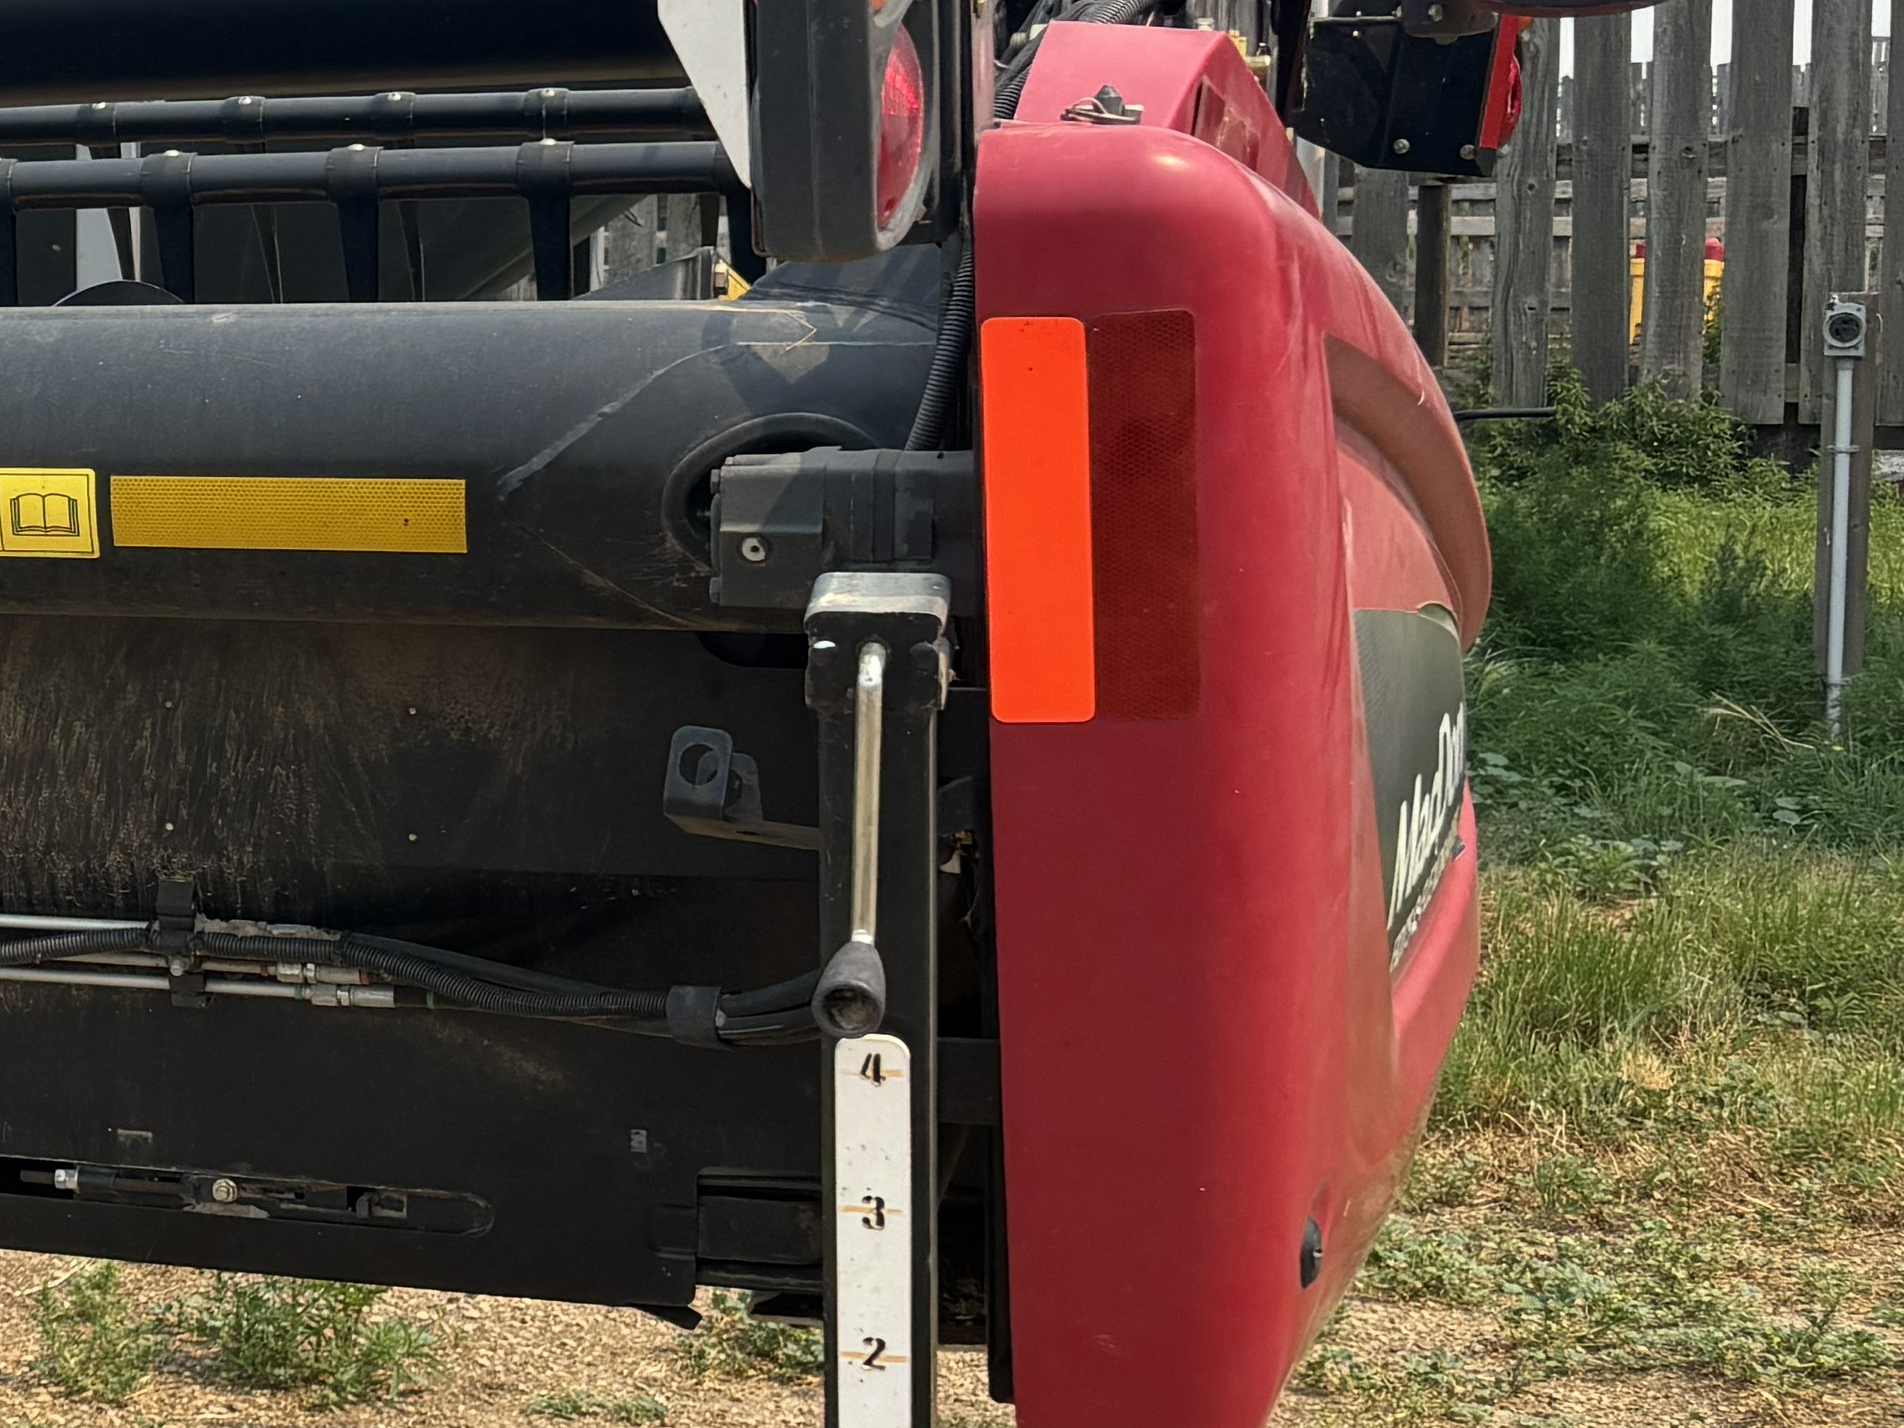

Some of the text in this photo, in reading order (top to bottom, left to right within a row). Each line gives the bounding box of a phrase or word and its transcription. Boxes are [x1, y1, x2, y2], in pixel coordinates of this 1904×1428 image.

[860, 1053, 887, 1088] 4
[862, 1195, 886, 1230] 3
[861, 1336, 887, 1371] 2
